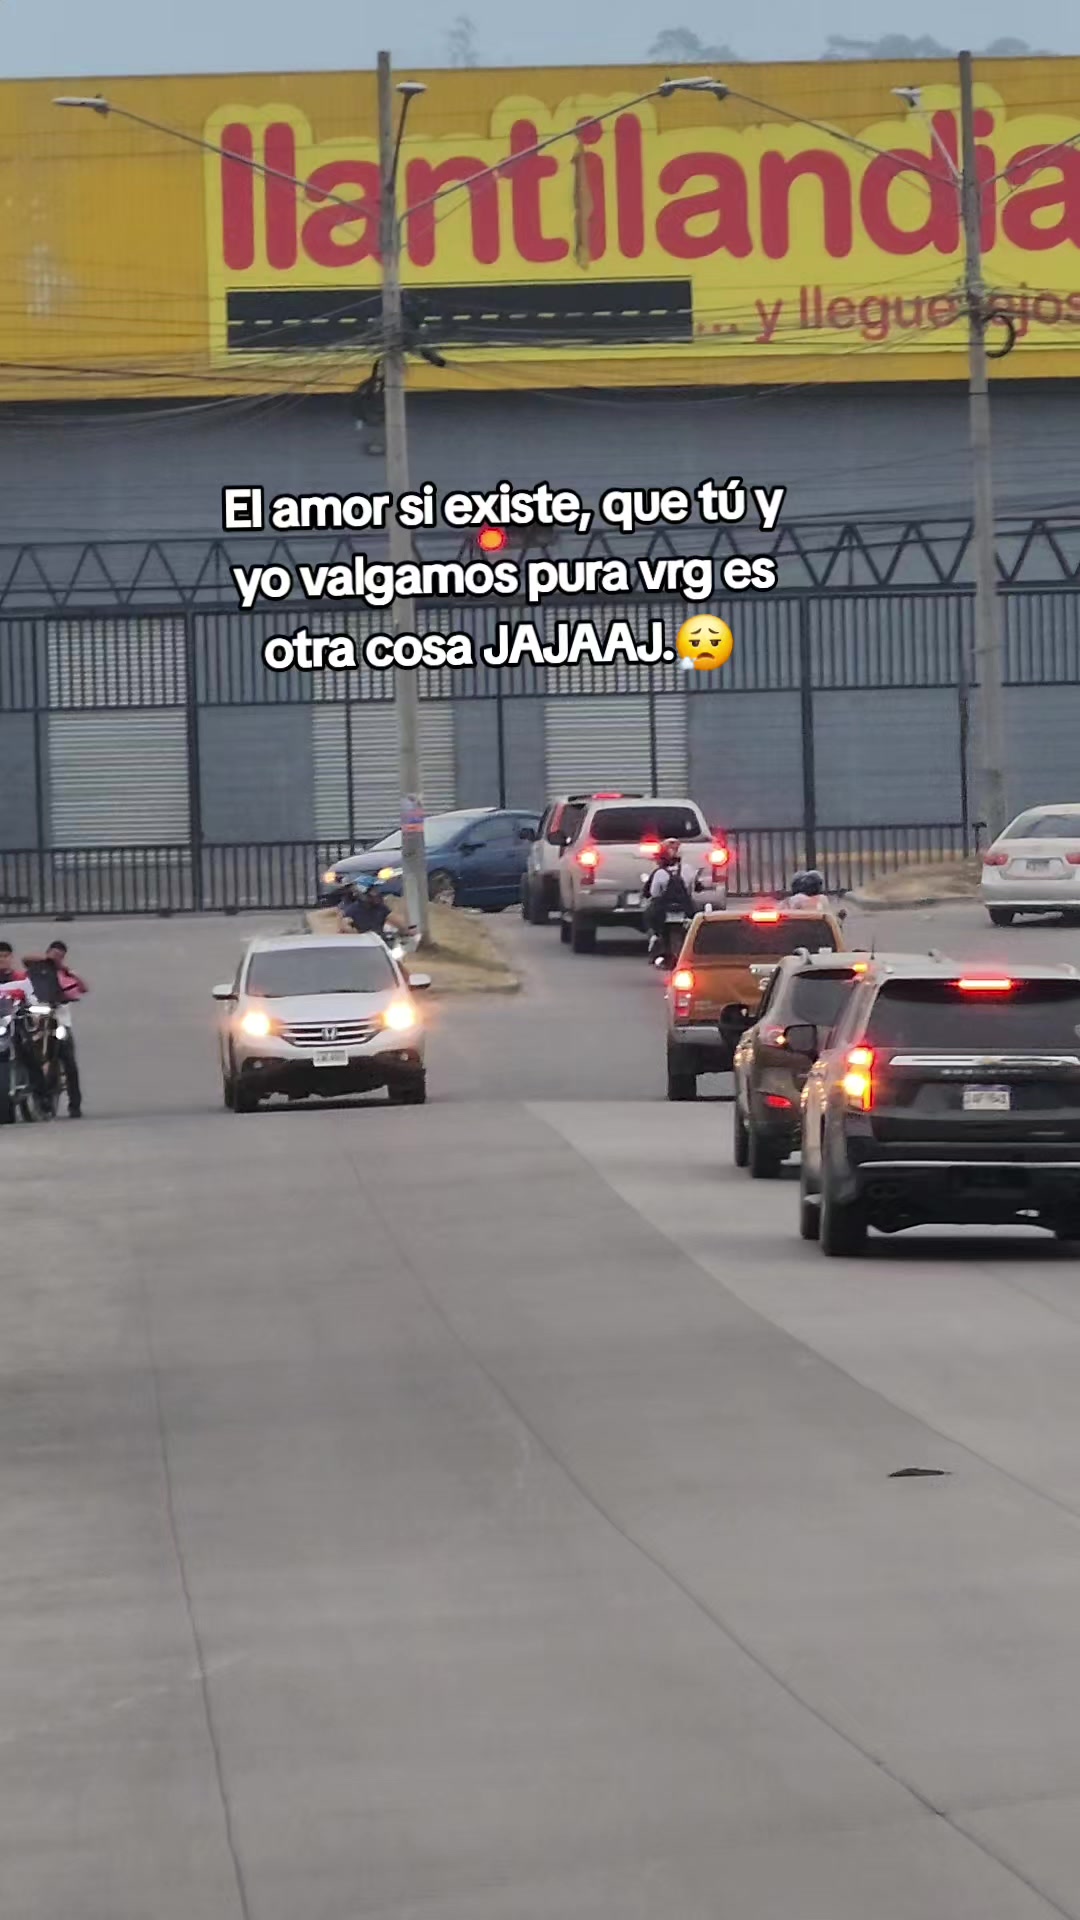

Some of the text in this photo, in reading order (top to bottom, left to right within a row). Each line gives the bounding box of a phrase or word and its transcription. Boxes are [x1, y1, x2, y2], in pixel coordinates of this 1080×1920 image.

[220, 110, 1080, 271] llantilandia
[755, 298, 784, 344] y
[800, 284, 957, 341] llegue
